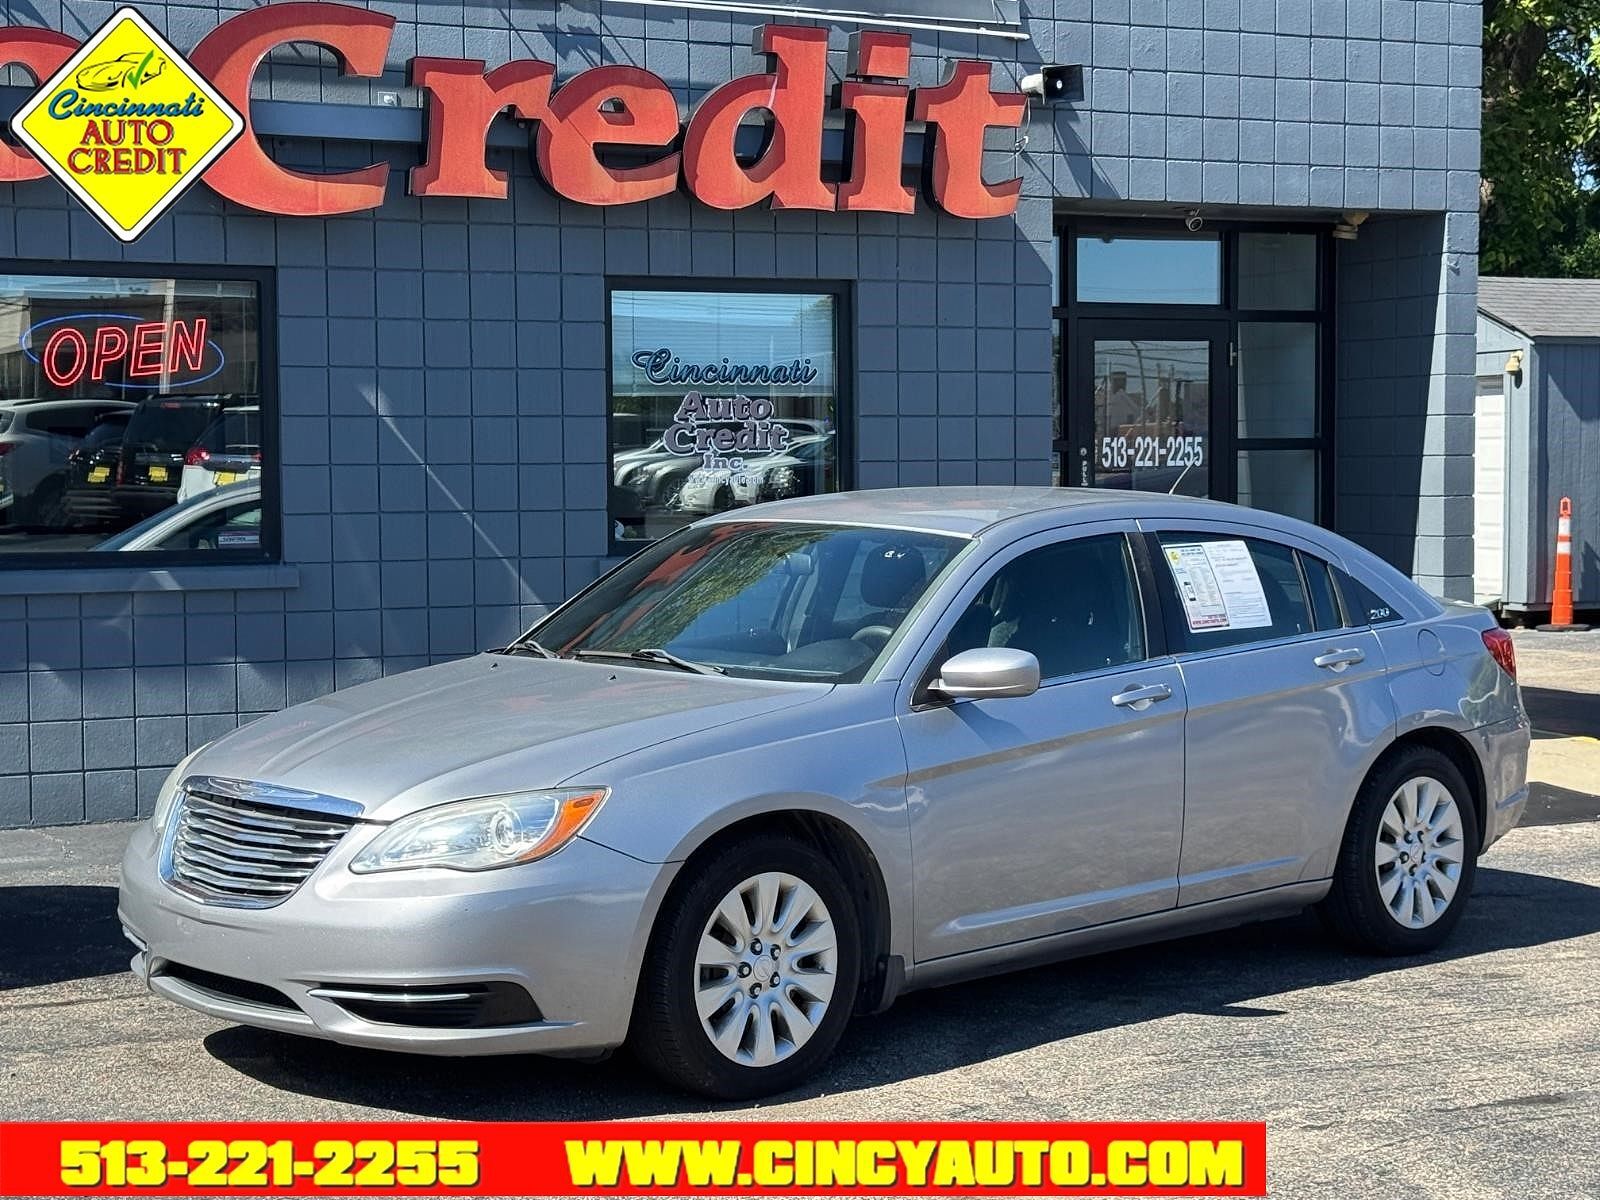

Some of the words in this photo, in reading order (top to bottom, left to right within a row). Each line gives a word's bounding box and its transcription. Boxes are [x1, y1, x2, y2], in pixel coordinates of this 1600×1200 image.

[187, 2, 1028, 219] Credit
[43, 318, 208, 387] OPEN
[631, 347, 818, 386] Cincinnati
[674, 390, 775, 423] Auto
[663, 420, 790, 456] Credit
[1101, 436, 1204, 468] 513-221-2255
[702, 453, 748, 471] Inc.
